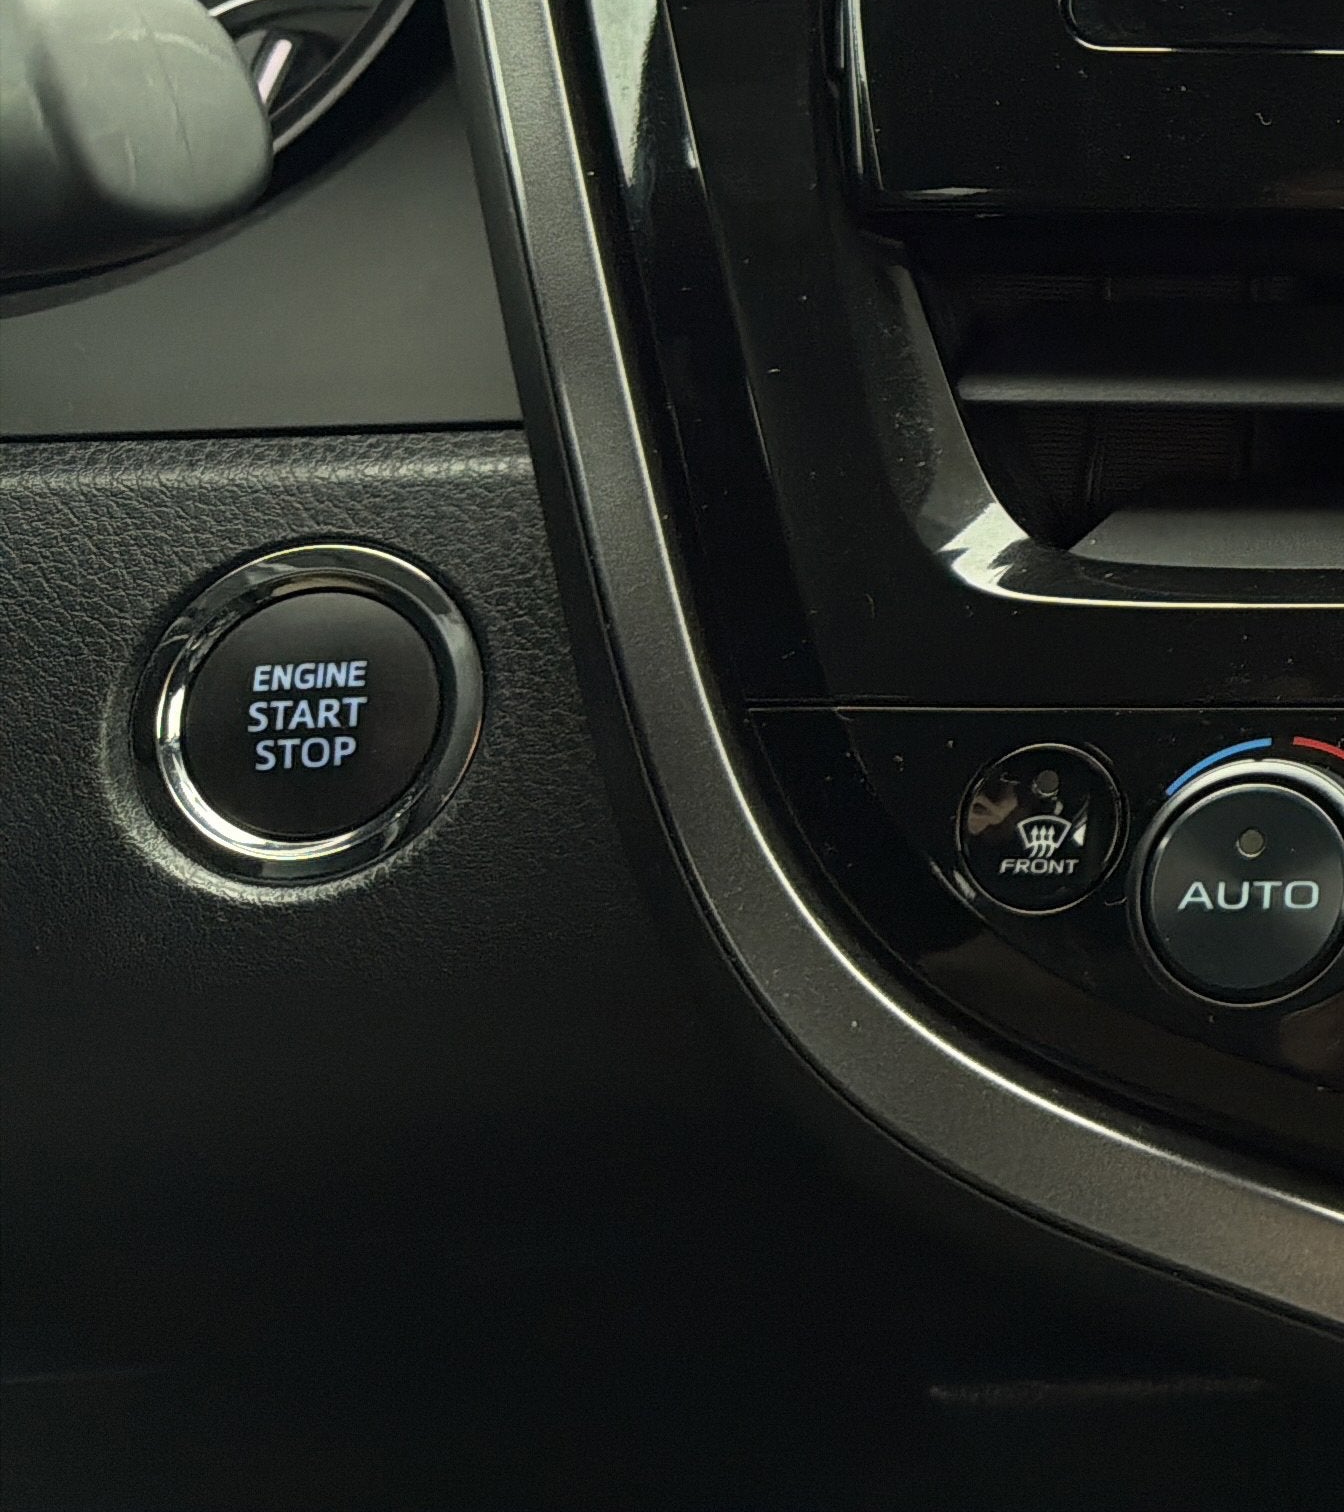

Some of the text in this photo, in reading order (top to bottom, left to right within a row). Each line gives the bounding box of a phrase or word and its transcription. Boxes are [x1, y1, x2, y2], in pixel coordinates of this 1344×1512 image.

[253, 660, 368, 692] ENGINE
[247, 696, 368, 733] START
[255, 736, 357, 771] STOP
[999, 857, 1080, 876] FRONT
[1177, 879, 1320, 912] AUTO
